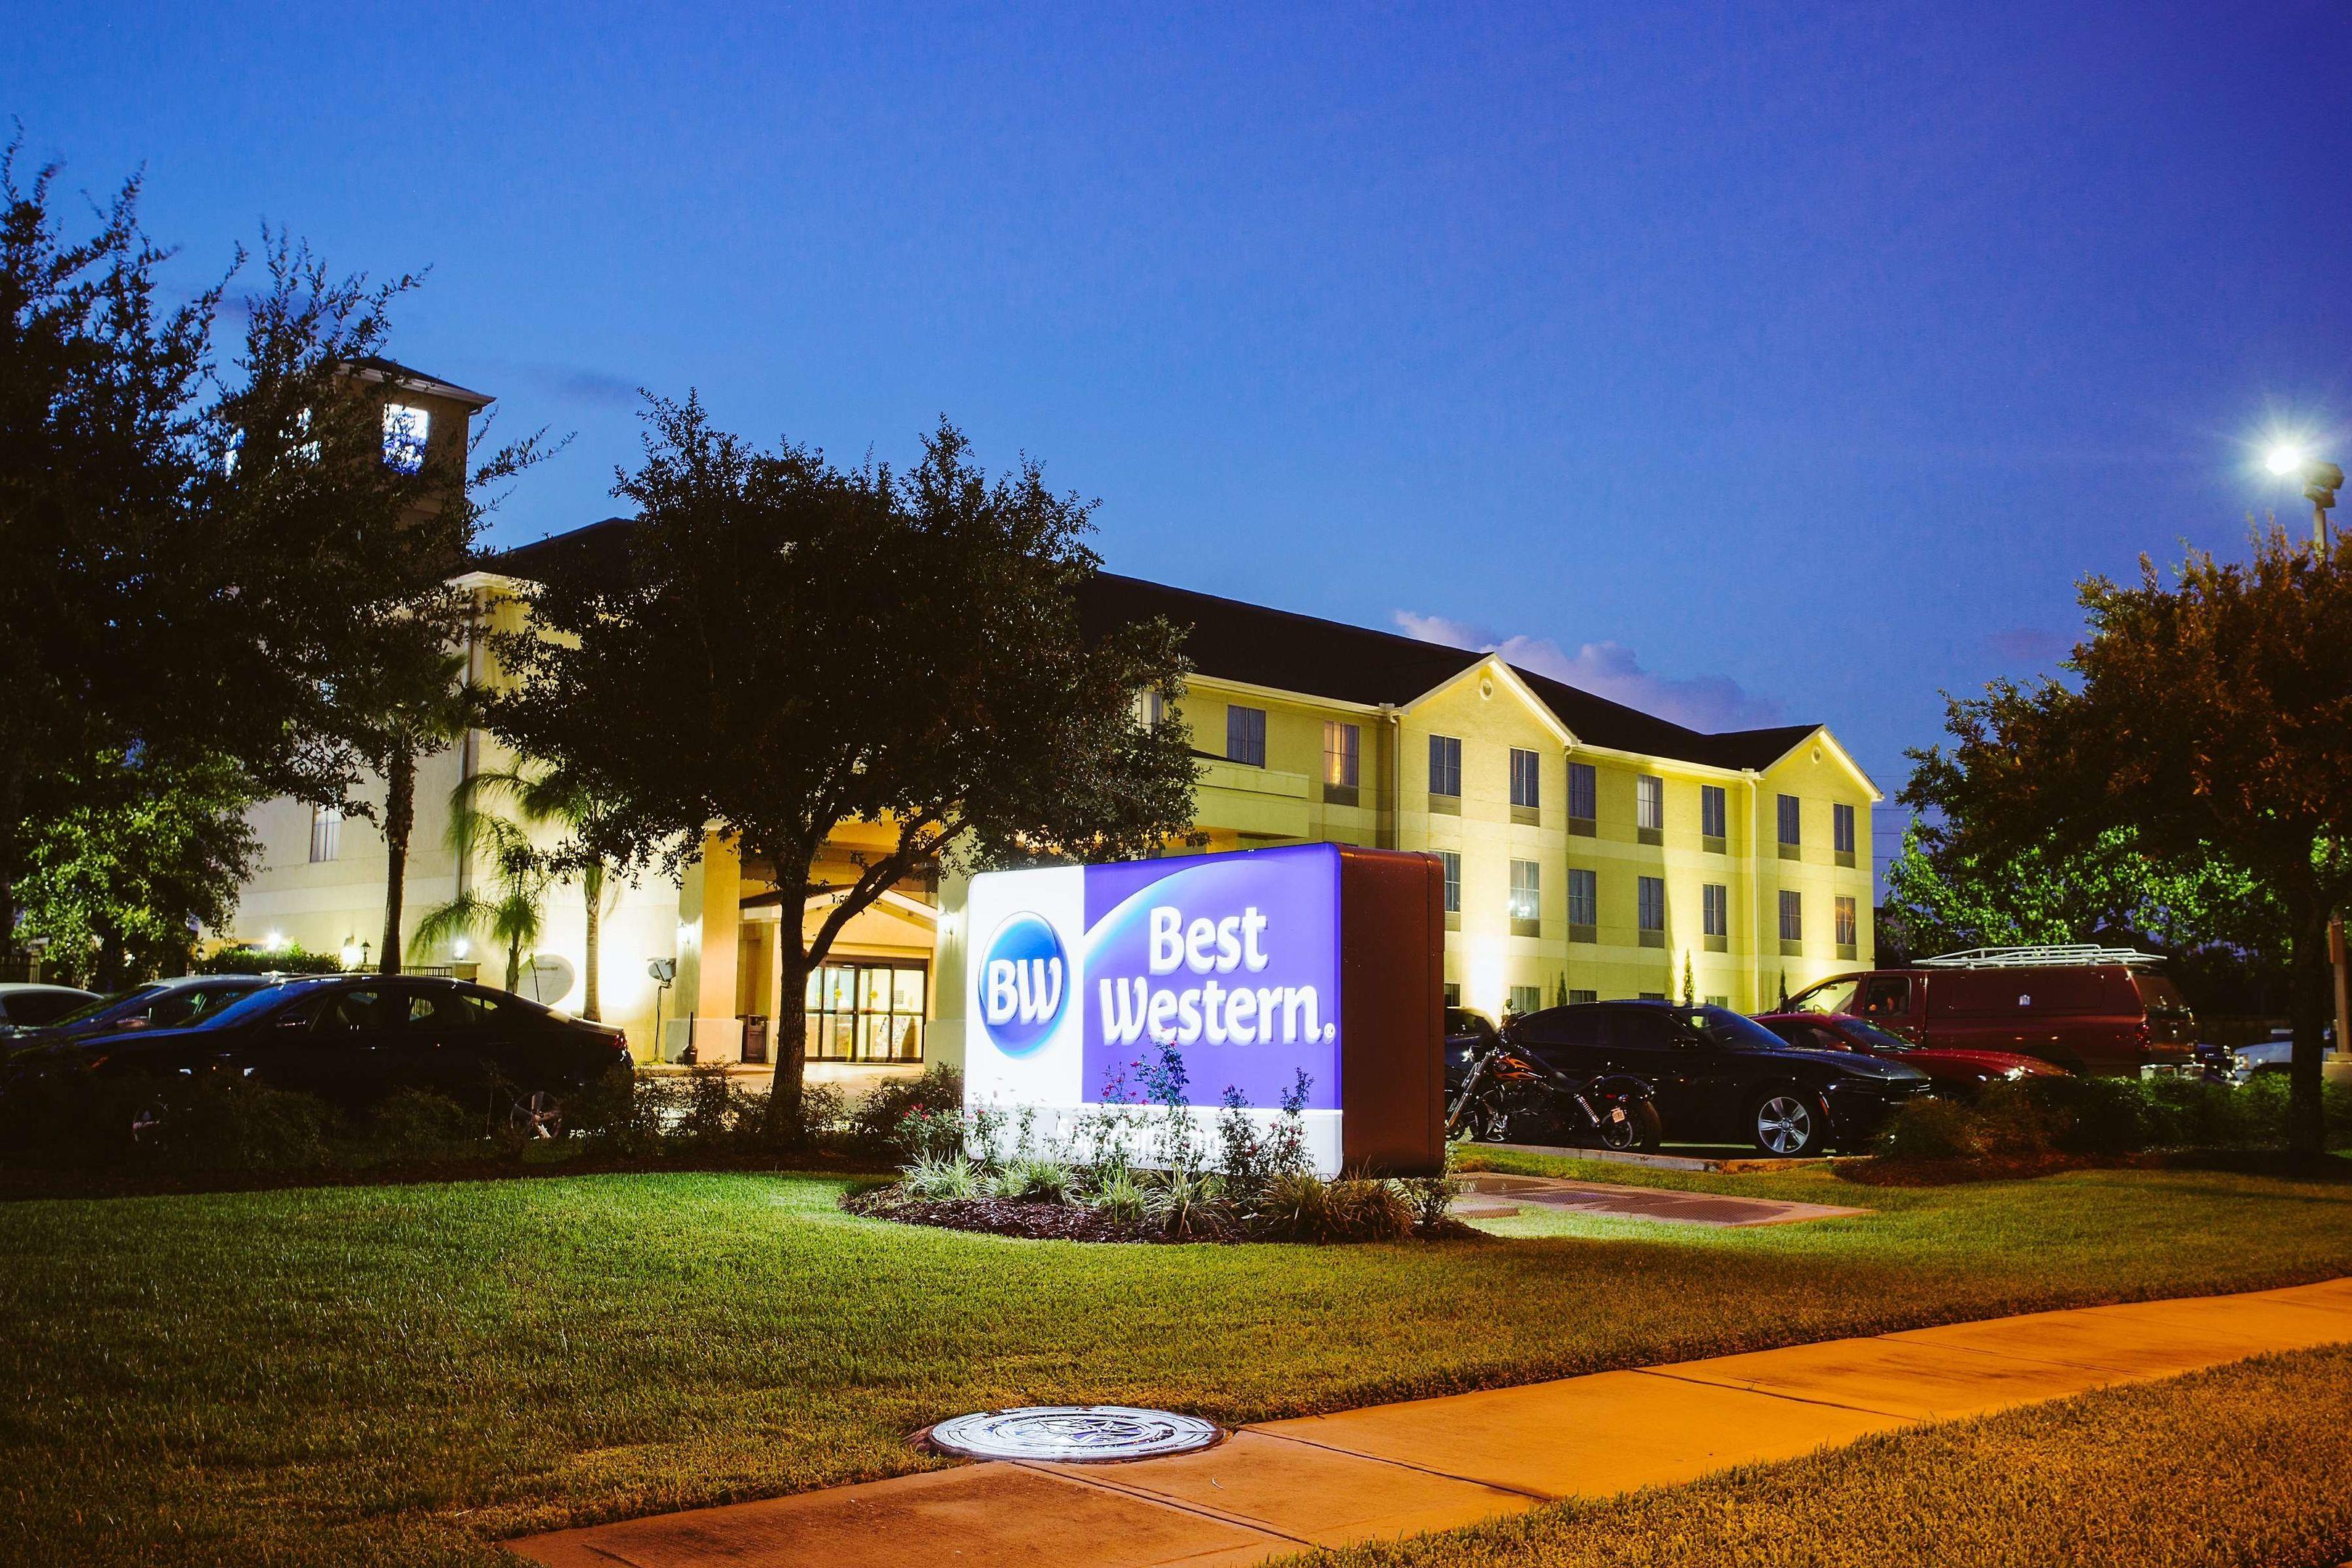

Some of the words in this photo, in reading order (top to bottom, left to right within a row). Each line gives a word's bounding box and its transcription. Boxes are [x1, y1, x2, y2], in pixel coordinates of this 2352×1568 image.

[1149, 906, 1267, 975] Best
[987, 957, 1063, 1025] BW
[1099, 976, 1321, 1046] Western
